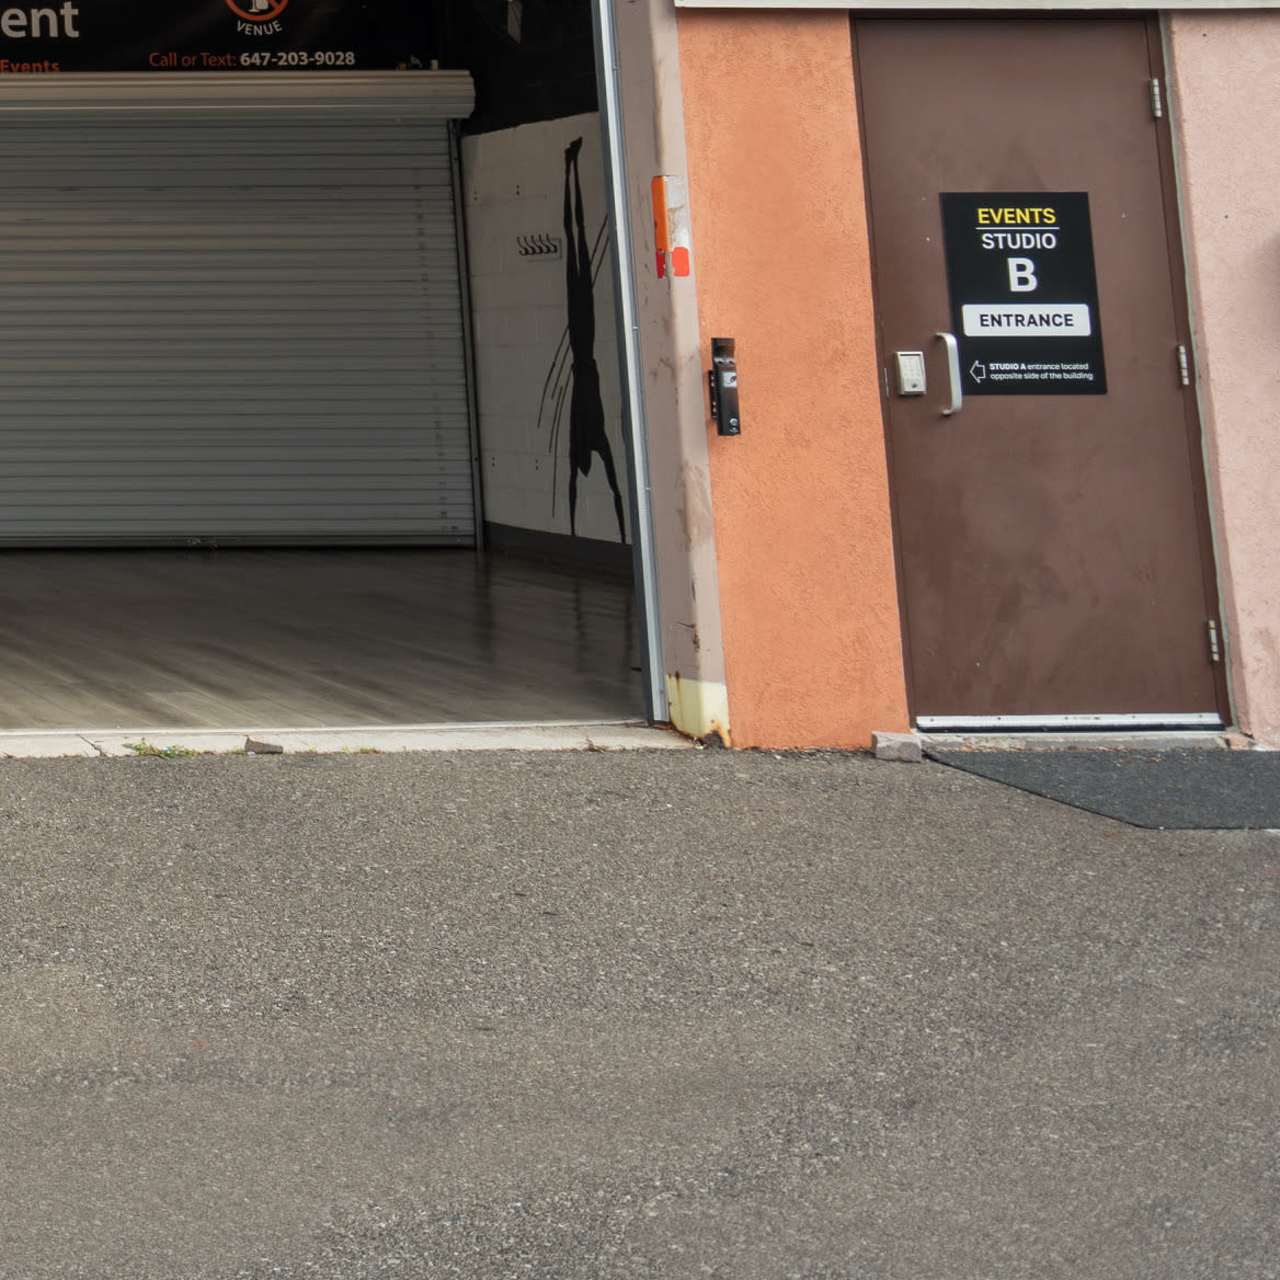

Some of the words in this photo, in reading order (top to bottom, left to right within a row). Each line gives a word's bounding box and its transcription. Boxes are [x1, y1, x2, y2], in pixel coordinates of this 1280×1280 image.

[236, 19, 283, 36] VENUE
[0, 60, 60, 72] Events
[148, 51, 178, 67] Call
[180, 56, 197, 67] or
[199, 52, 238, 67] Text:
[239, 51, 356, 67] 647-203-9028
[977, 208, 1057, 224] EVENTS
[981, 233, 1057, 249] STUDIO
[1007, 257, 1039, 292] B
[979, 313, 1075, 327] ENTRANCE
[990, 372, 1023, 380] opposite
[1063, 372, 1093, 380] building
